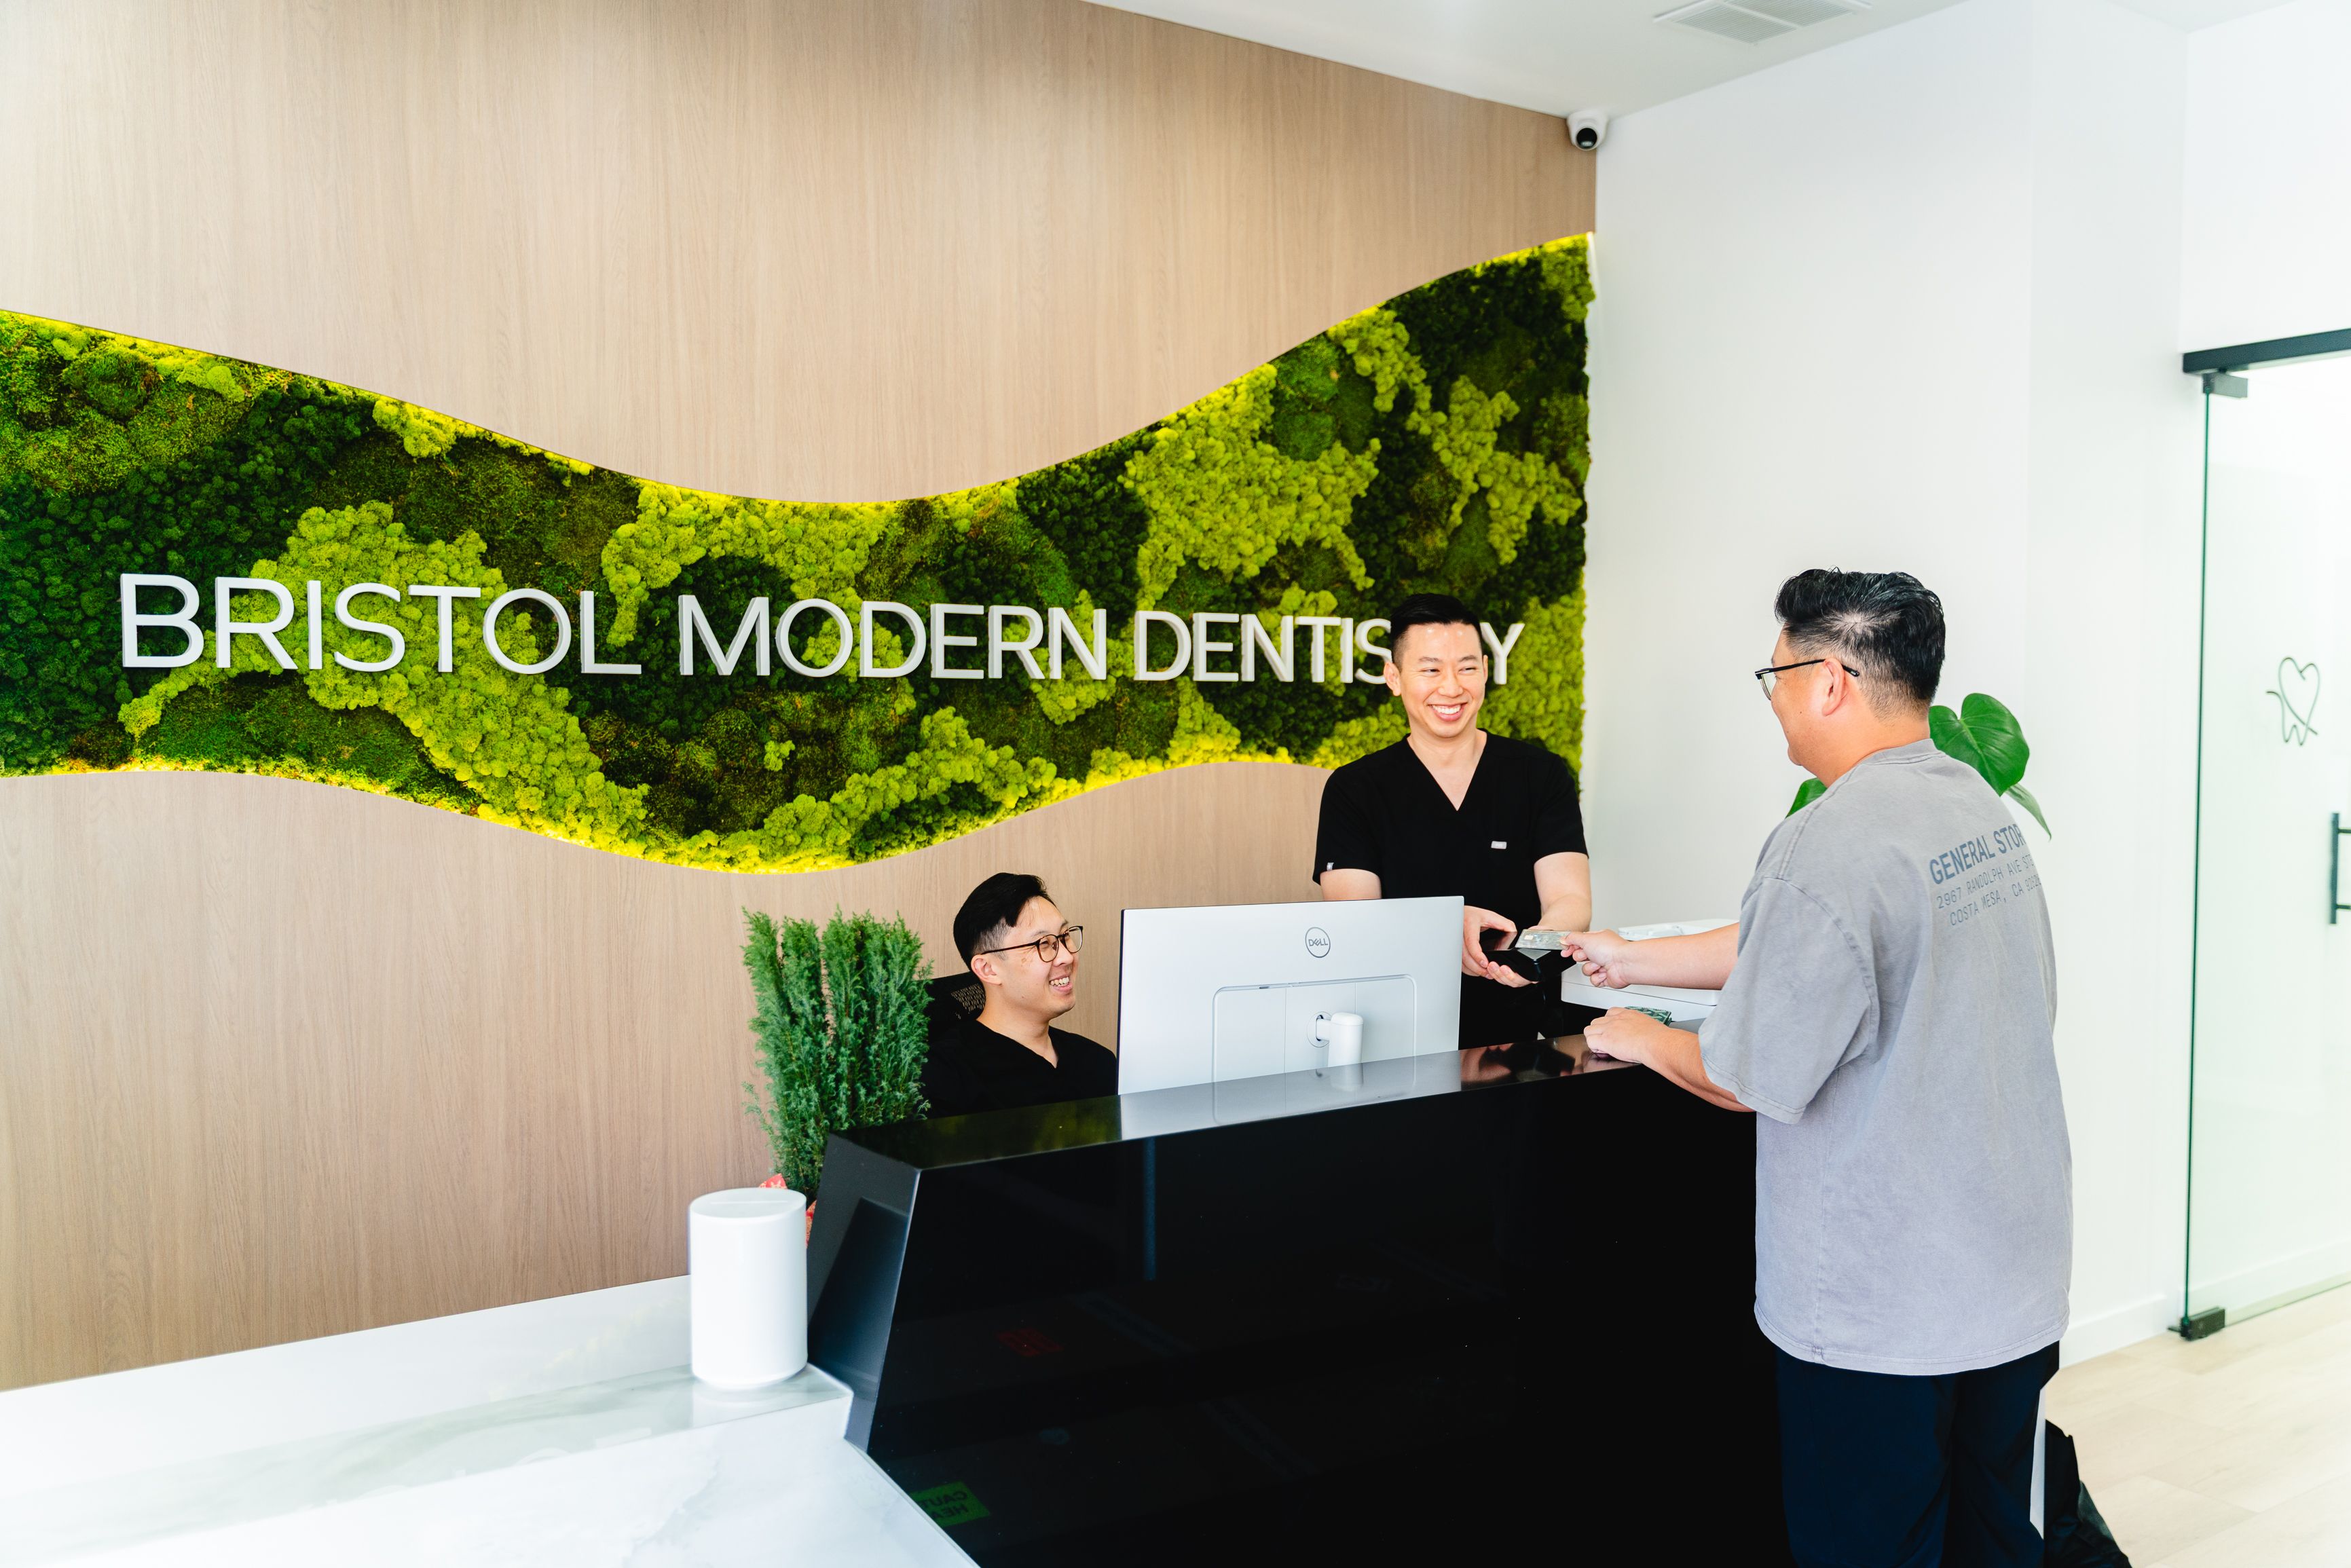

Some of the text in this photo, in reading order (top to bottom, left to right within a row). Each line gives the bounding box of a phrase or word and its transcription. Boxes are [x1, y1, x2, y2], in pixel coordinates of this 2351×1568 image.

[120, 574, 1525, 685] BRISTOL MODERN DENTISY
[1929, 823, 2026, 884] GENERAL STOR
[1936, 886, 1961, 909] 2967
[1966, 866, 2004, 895] RANDOLPH
[2007, 859, 2022, 876] AVE
[1949, 901, 1980, 926] COSTA
[1981, 890, 2007, 910] MESA,
[2011, 882, 2024, 897] CA
[1308, 938, 1329, 947] DELL
